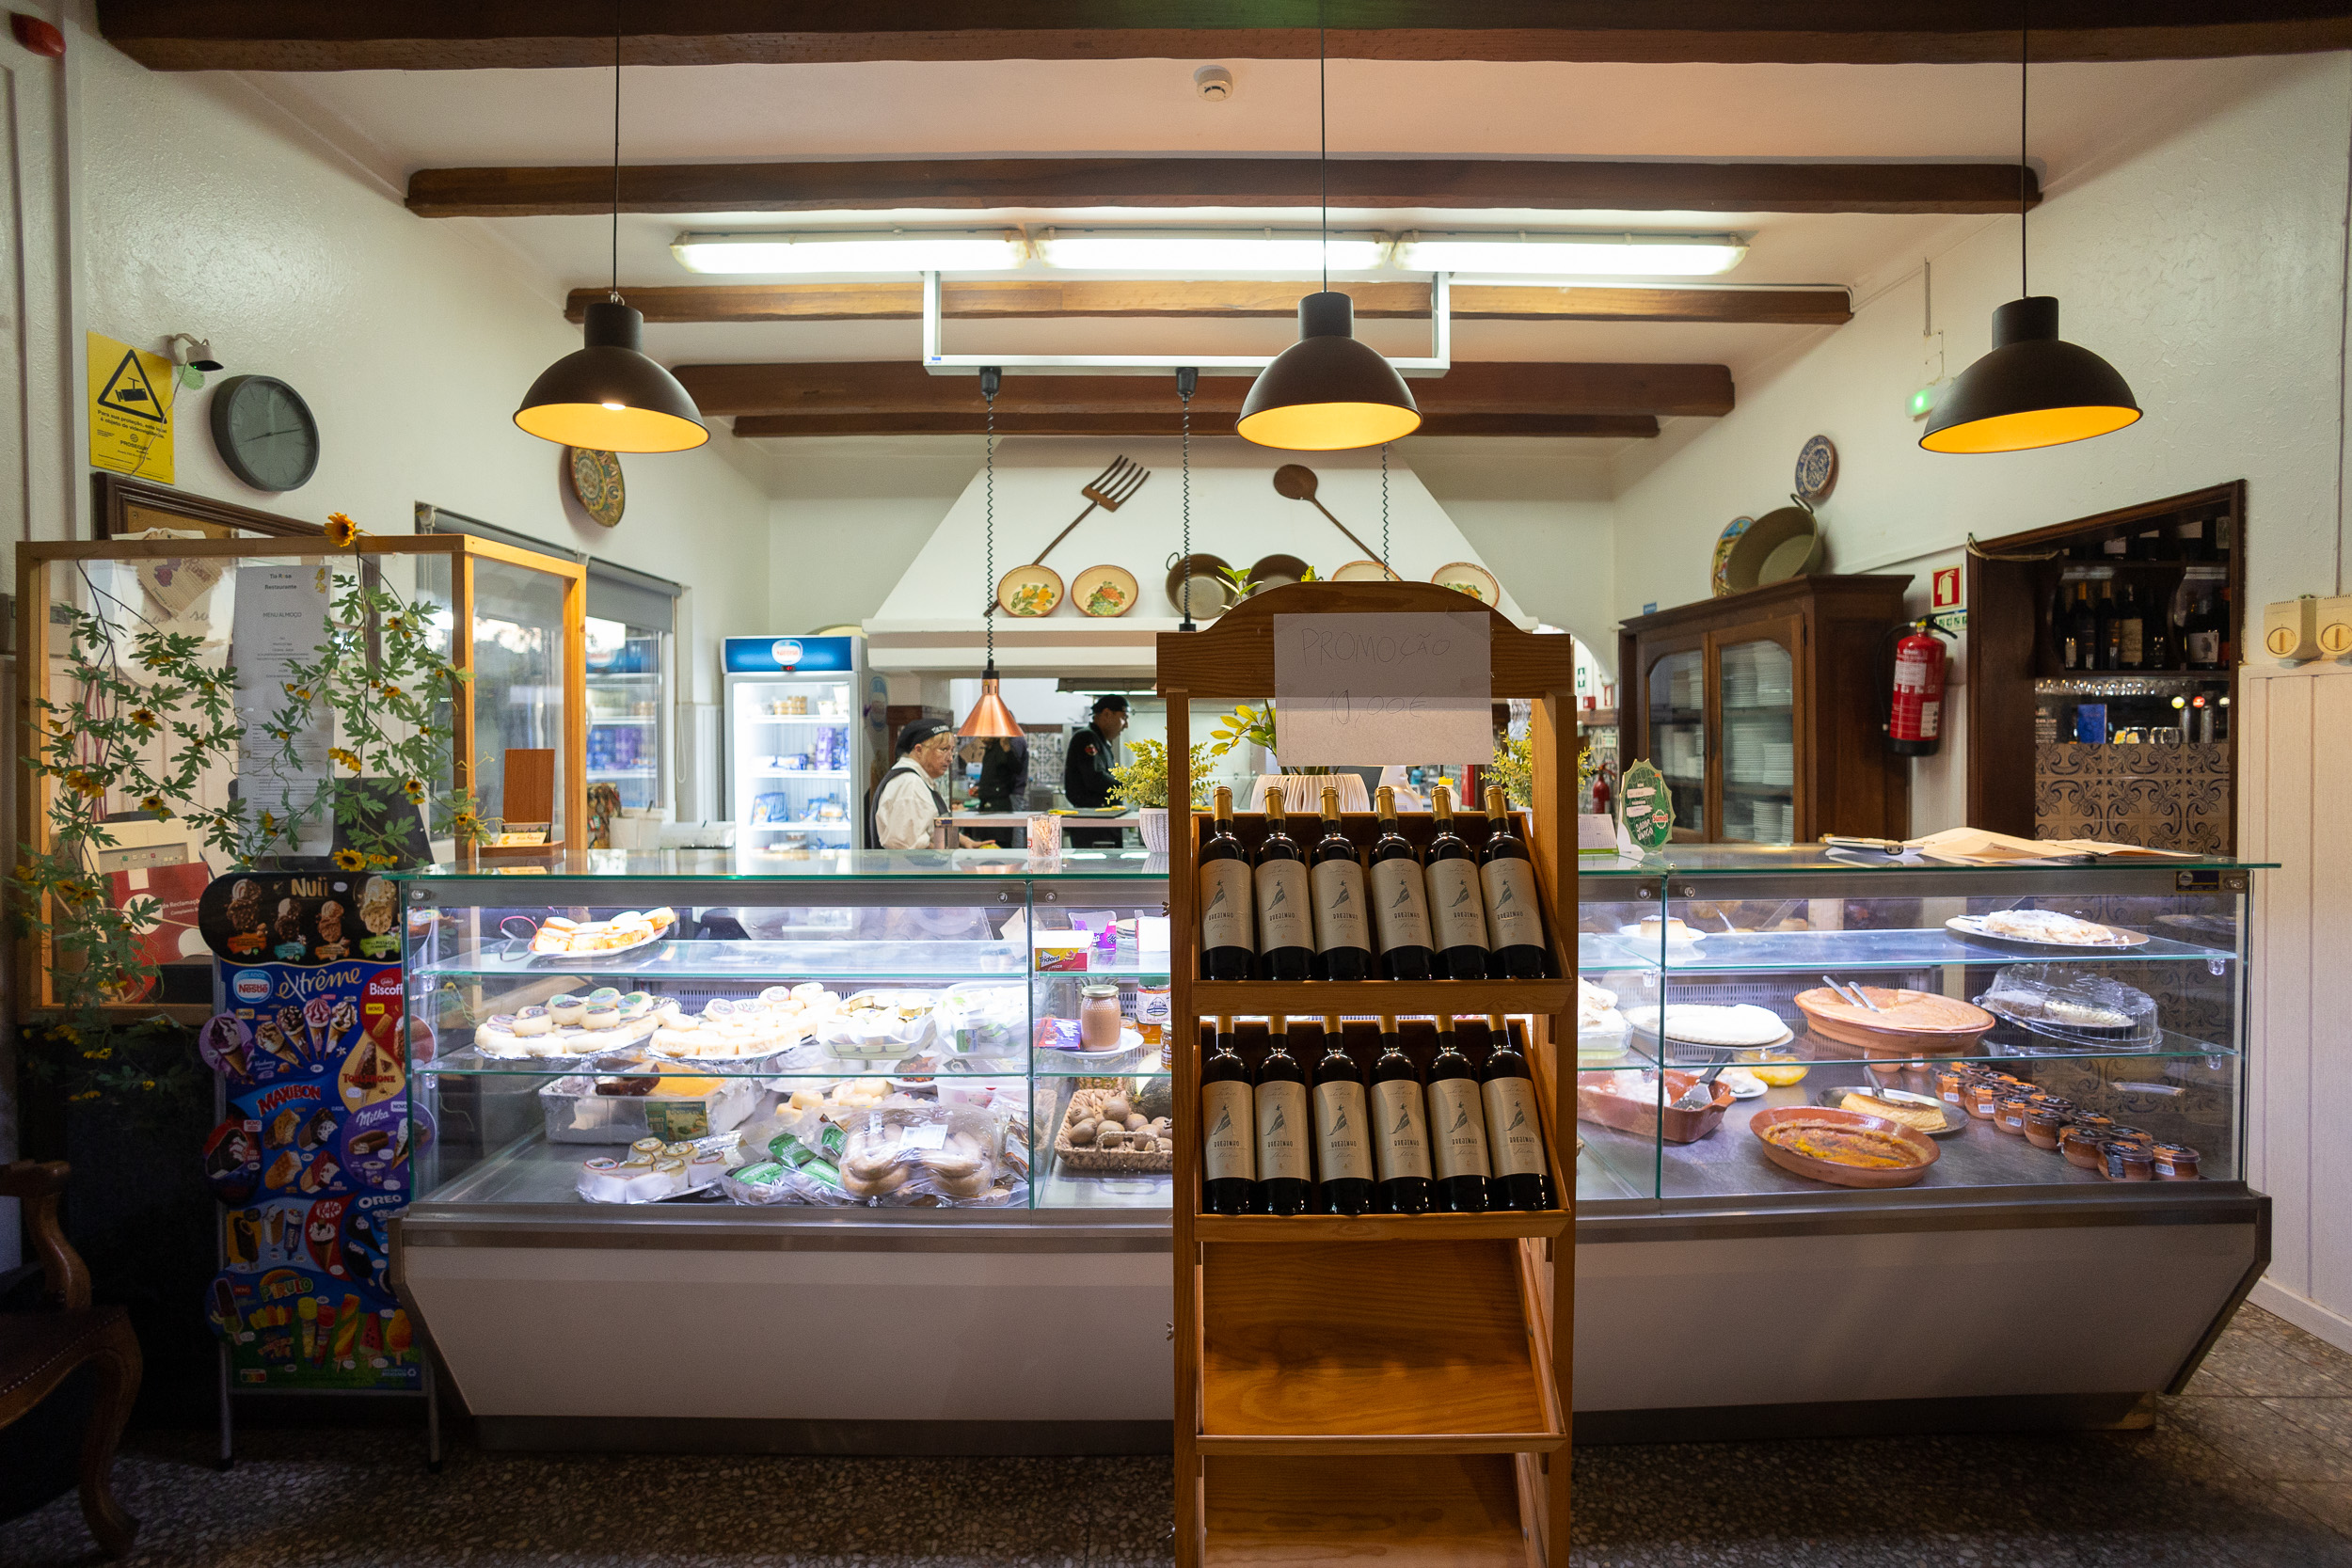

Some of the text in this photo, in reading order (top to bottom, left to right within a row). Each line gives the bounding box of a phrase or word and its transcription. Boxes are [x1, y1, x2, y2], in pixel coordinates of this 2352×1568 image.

[97, 409, 110, 418] Para
[1301, 627, 1451, 666] PROMOÇÃO
[169, 897, 200, 908] Reclamaçõ
[1038, 955, 1060, 963] Trident
[238, 983, 269, 994] Nestlé
[369, 982, 404, 995] Biscoff
[342, 1072, 397, 1084] TOBLERONE
[256, 1084, 322, 1117] MAXIBON
[356, 1108, 390, 1128] Milka
[358, 1194, 403, 1210] OREO
[260, 1276, 314, 1303] PIRULO
